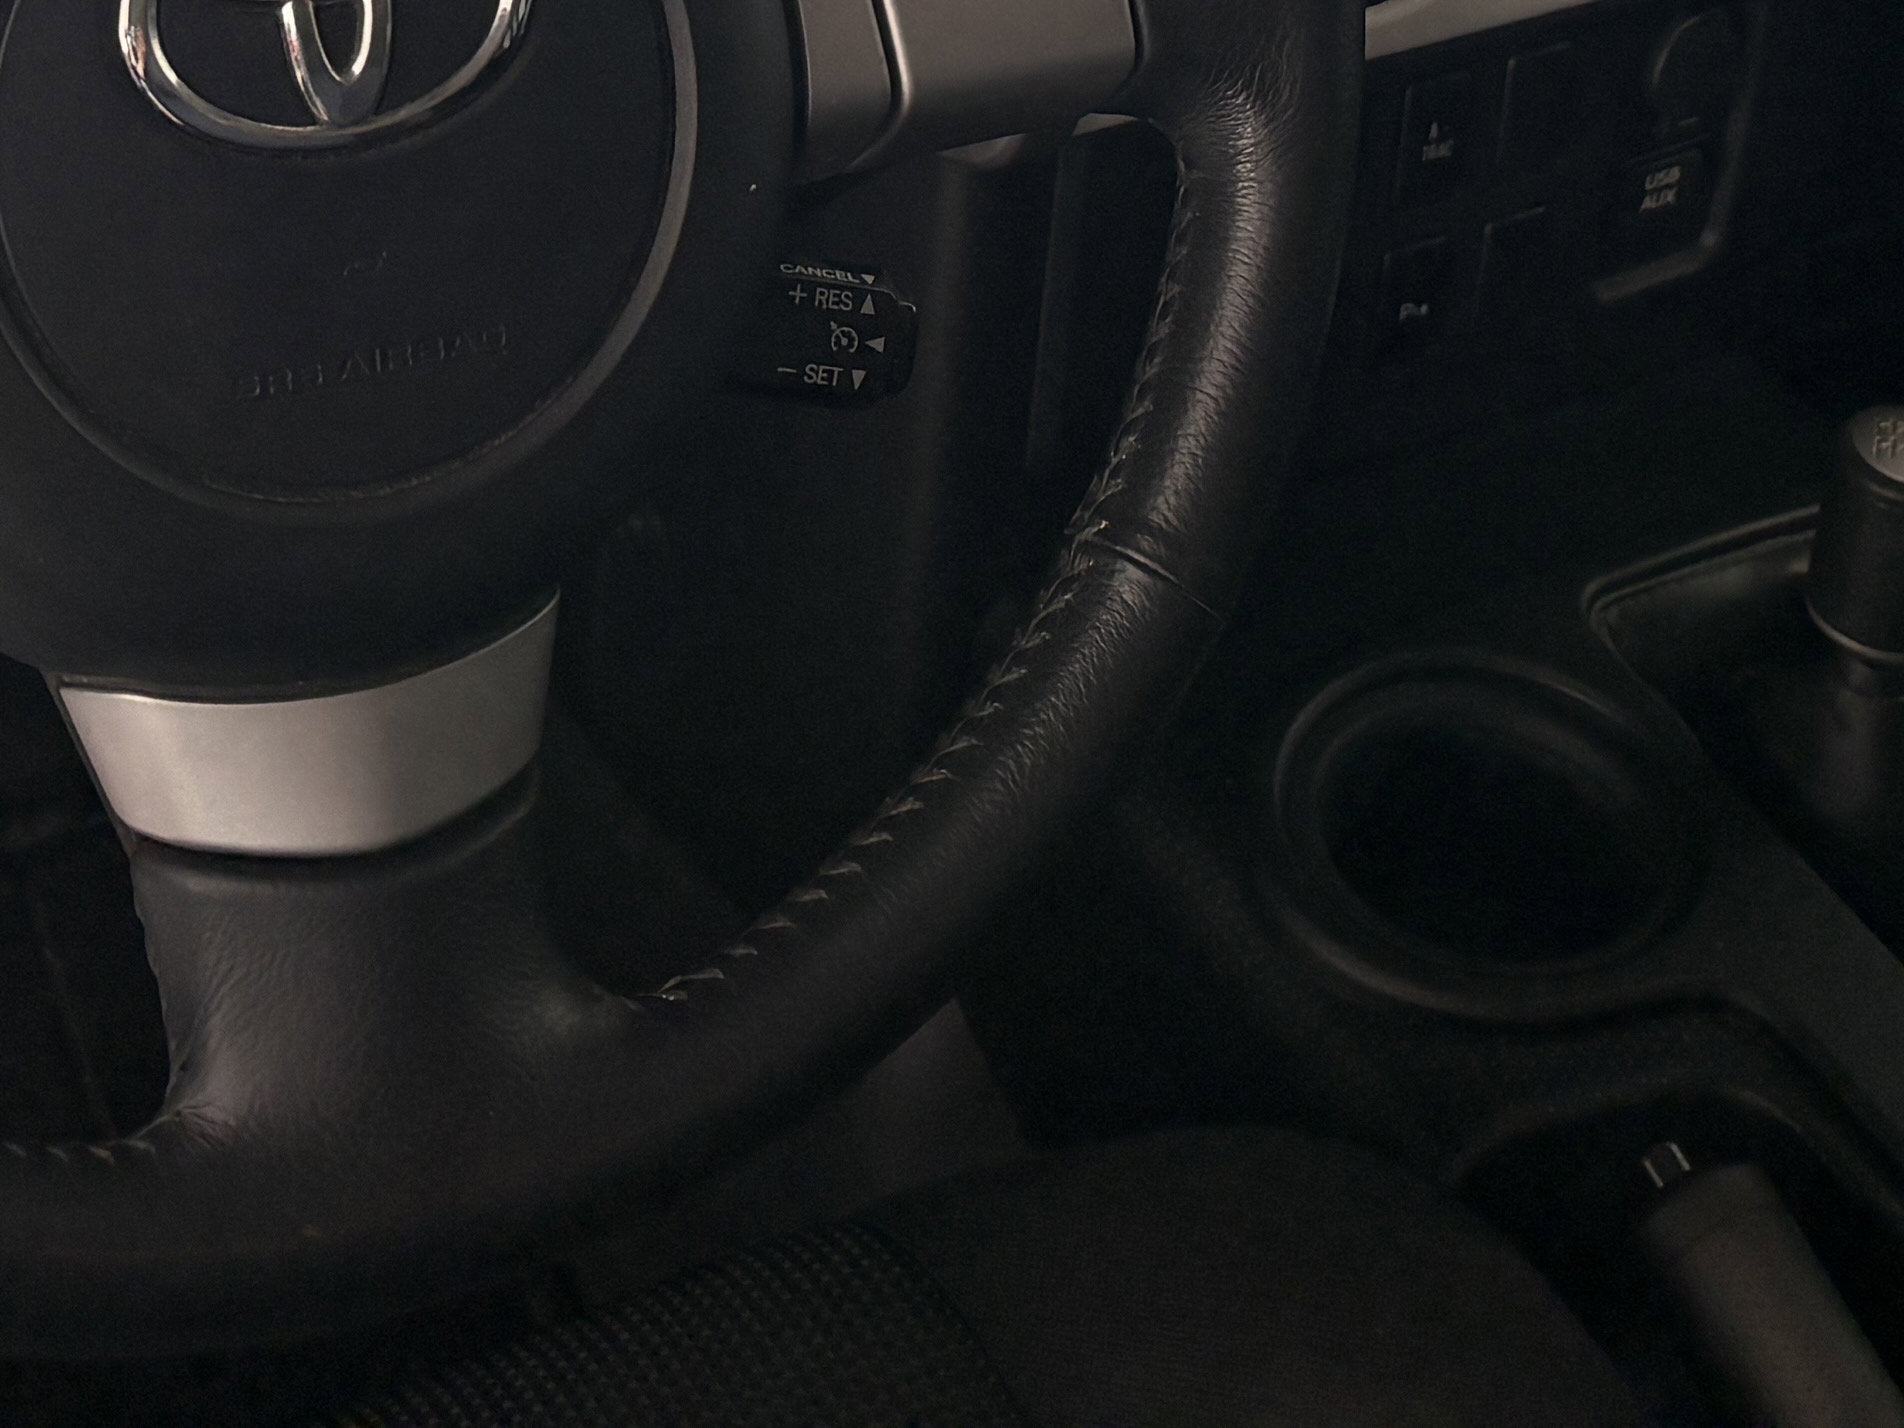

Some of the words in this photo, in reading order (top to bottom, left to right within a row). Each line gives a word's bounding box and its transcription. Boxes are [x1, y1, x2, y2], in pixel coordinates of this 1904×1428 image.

[779, 263, 862, 284] CANCEL
[814, 287, 854, 311] RES
[803, 363, 845, 388] SET
